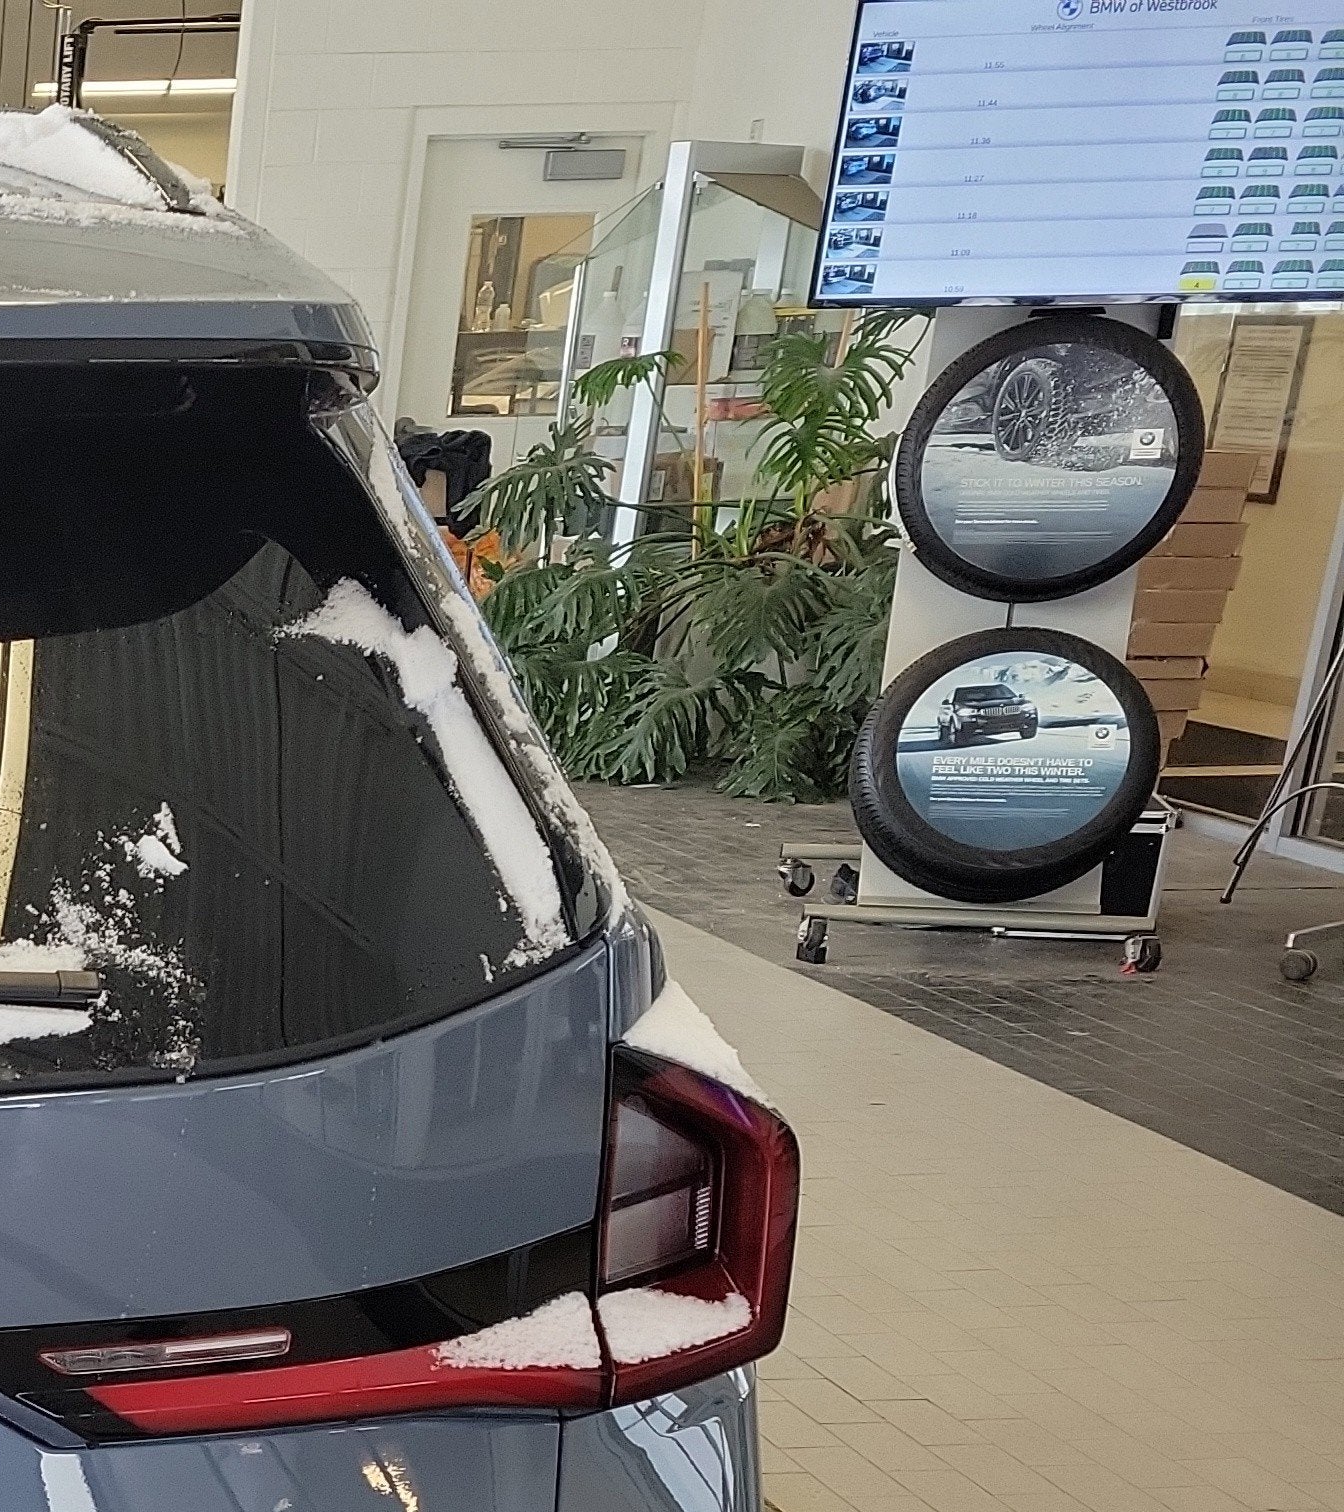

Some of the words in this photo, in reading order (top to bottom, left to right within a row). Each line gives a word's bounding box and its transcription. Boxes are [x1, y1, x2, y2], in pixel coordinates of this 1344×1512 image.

[1090, 0, 1126, 14] BMW
[1129, 0, 1144, 12] of
[1147, 0, 1218, 12] Westbrook
[873, 30, 899, 38] Vehicle
[62, 36, 75, 63] LIFT
[1008, 477, 1022, 488] TO
[1025, 477, 1065, 488] WINTER
[1070, 477, 1093, 487] THIS
[1095, 476, 1143, 487] SEASON.
[933, 756, 968, 765] EVERY
[969, 757, 995, 765] MILE
[997, 757, 1044, 766] DOESN'T
[1046, 758, 1075, 767] HAVE
[1076, 758, 1093, 767] TO
[932, 765, 959, 774] FEEL
[960, 765, 984, 774] LIKE
[986, 766, 1012, 775] TWO
[1014, 767, 1038, 775] THIS
[1041, 767, 1085, 776] WINTER.
